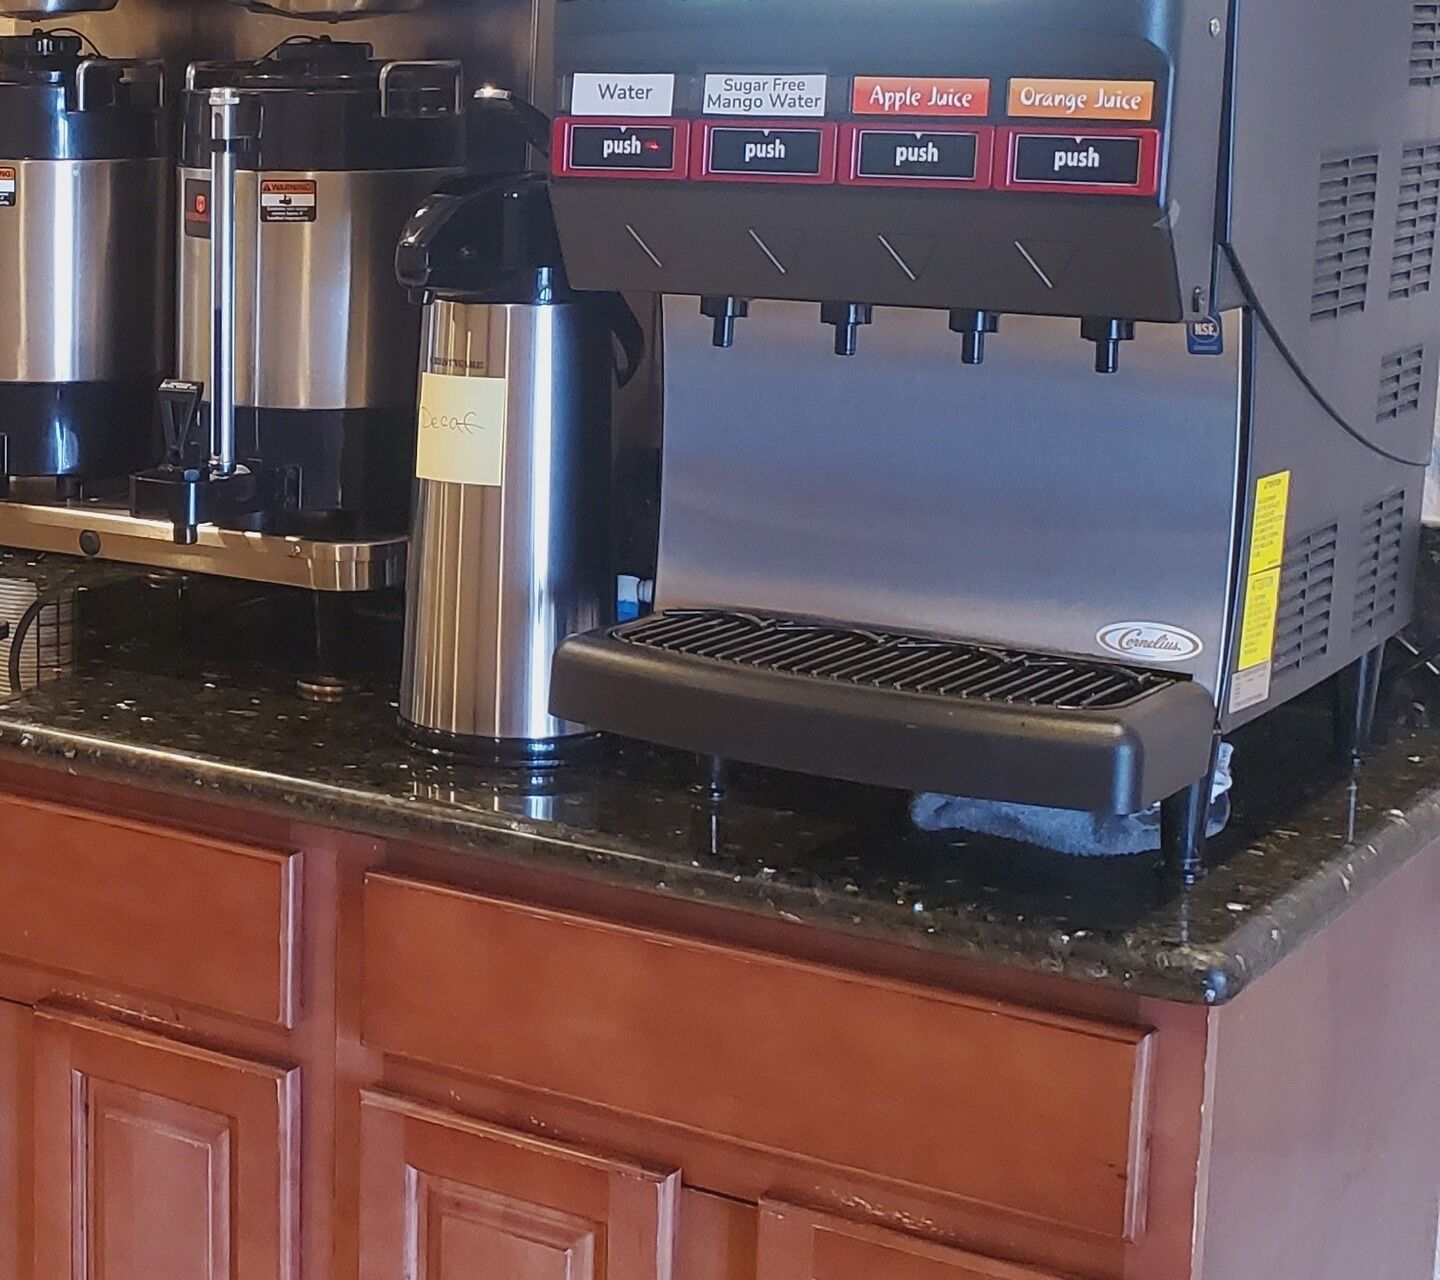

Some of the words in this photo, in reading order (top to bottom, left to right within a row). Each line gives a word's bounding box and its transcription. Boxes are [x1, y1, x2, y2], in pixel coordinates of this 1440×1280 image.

[598, 83, 653, 100] Water
[723, 78, 768, 95] Sugar
[773, 78, 806, 91] Free
[869, 84, 921, 112] Apple
[927, 86, 973, 108] Juice
[707, 94, 763, 112] Mango
[769, 93, 821, 108] Water
[1020, 86, 1087, 113] Orange
[1093, 87, 1142, 110] Juice
[602, 135, 641, 159] push
[744, 139, 785, 163] push
[895, 142, 939, 166] push
[1053, 147, 1100, 171] push
[421, 405, 486, 435] Decaf
[1118, 628, 1182, 651] Cornelius
